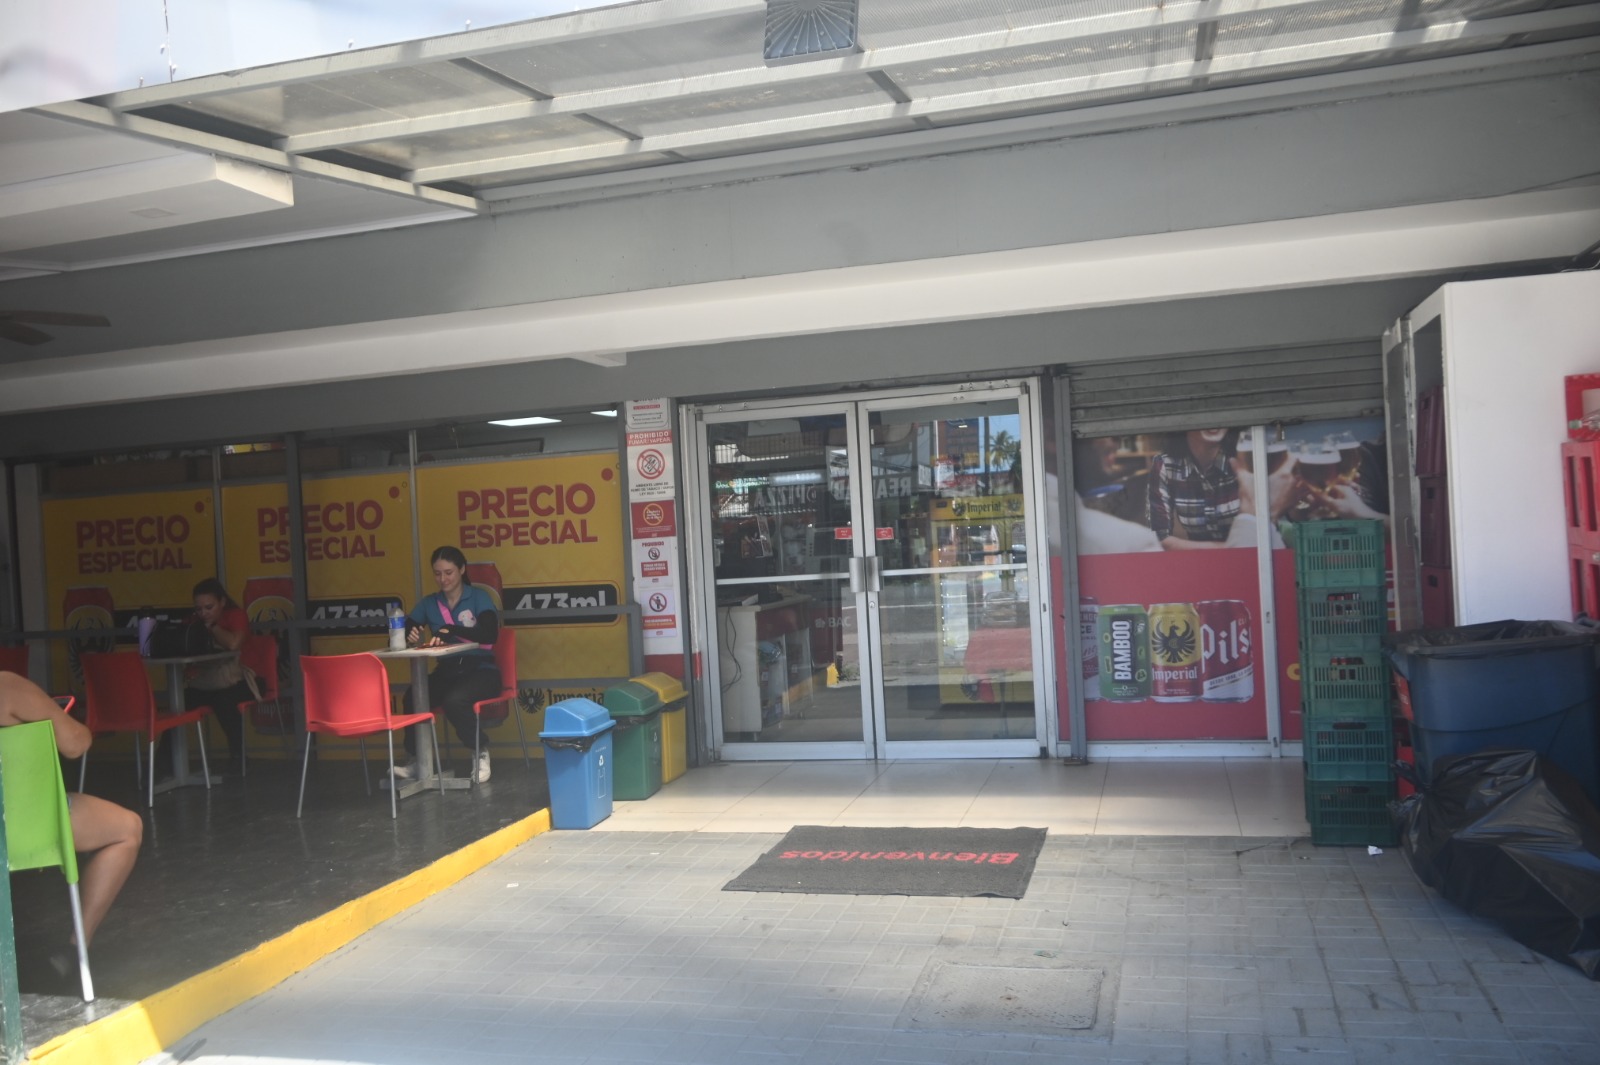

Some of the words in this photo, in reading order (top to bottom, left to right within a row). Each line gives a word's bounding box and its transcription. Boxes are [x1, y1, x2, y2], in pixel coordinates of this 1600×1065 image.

[629, 431, 669, 440] PROHIBIDO
[457, 483, 595, 520] PRECIO
[76, 514, 190, 548] PRECIO
[459, 519, 598, 549] ESPECIAL
[78, 547, 193, 573] ESPECIAL
[260, 535, 386, 563] ESECIAL
[515, 591, 606, 610] 473ml
[828, 616, 852, 628] BAC
[1112, 621, 1132, 680] BAMBOO
[1200, 620, 1249, 674] Pils
[1152, 667, 1198, 683] Imperial
[779, 850, 1020, 864] Bienvenidos
